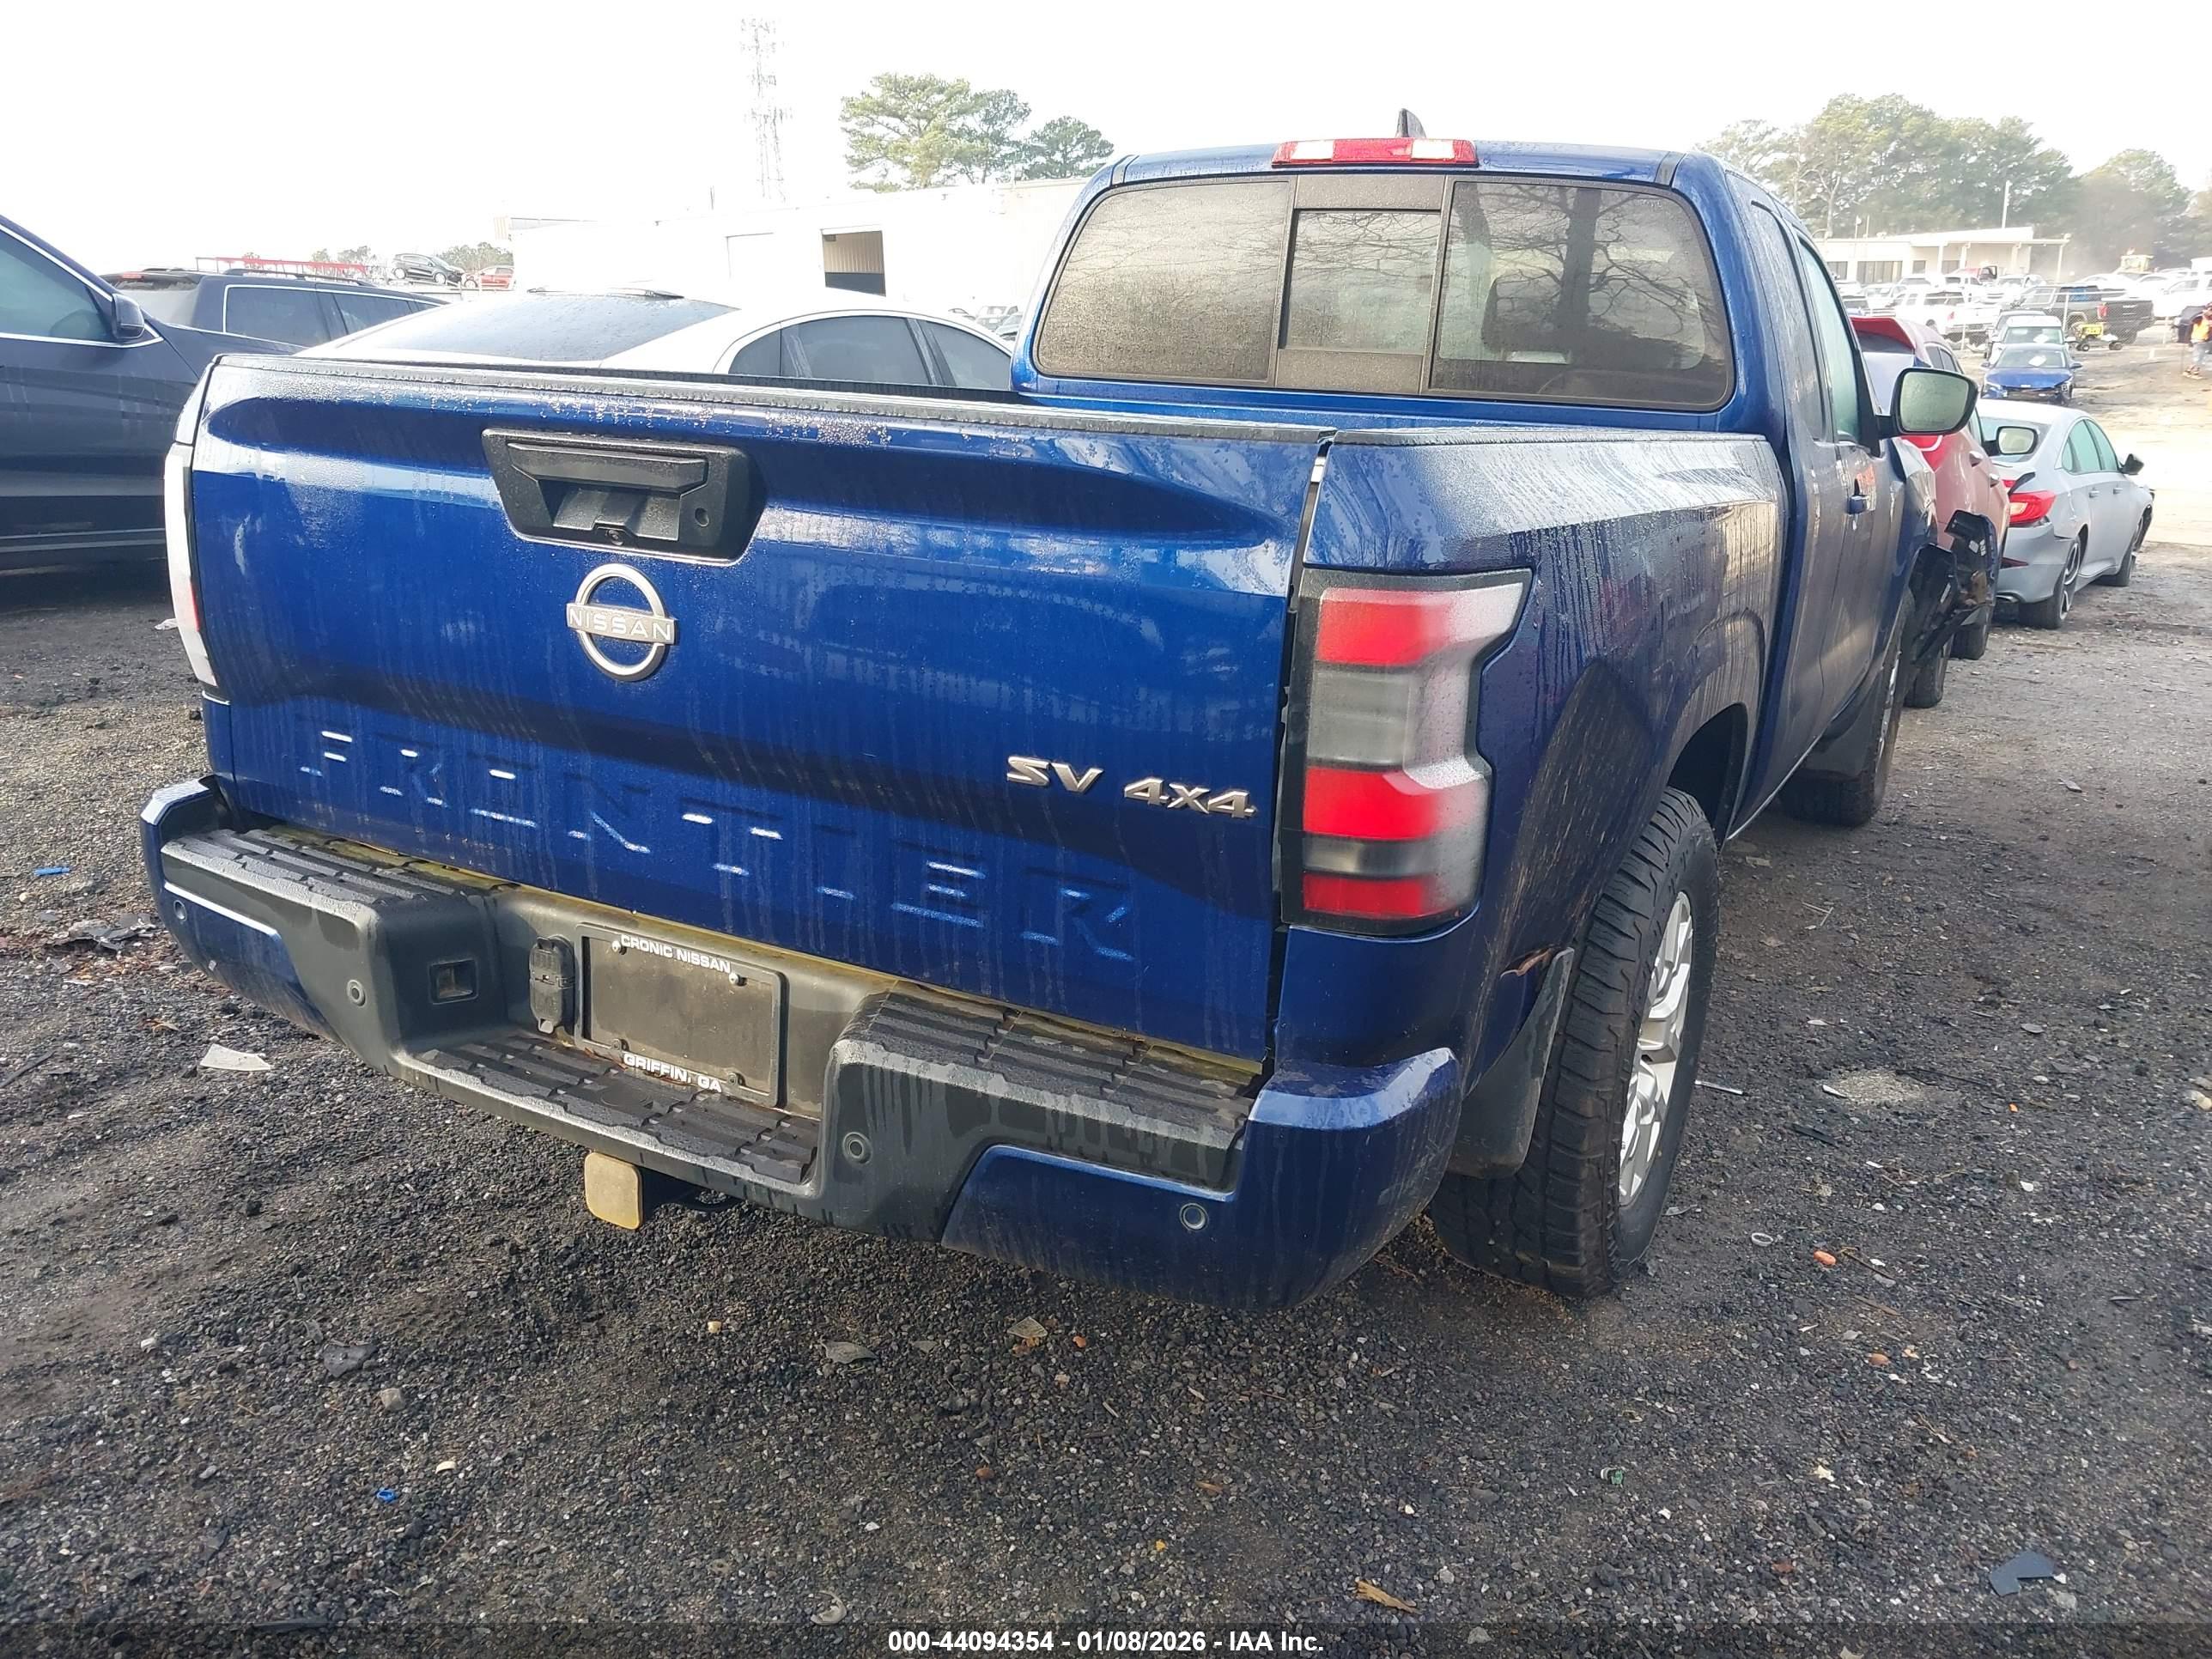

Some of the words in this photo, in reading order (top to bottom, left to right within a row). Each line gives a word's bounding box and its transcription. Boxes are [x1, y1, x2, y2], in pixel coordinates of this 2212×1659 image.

[568, 607, 672, 641] NISSAN
[1006, 755, 1104, 793] SV
[297, 715, 1136, 963] FRONTIER
[620, 933, 674, 960] CRONIC
[677, 949, 732, 974] NISSAN
[696, 1075, 723, 1094] GA
